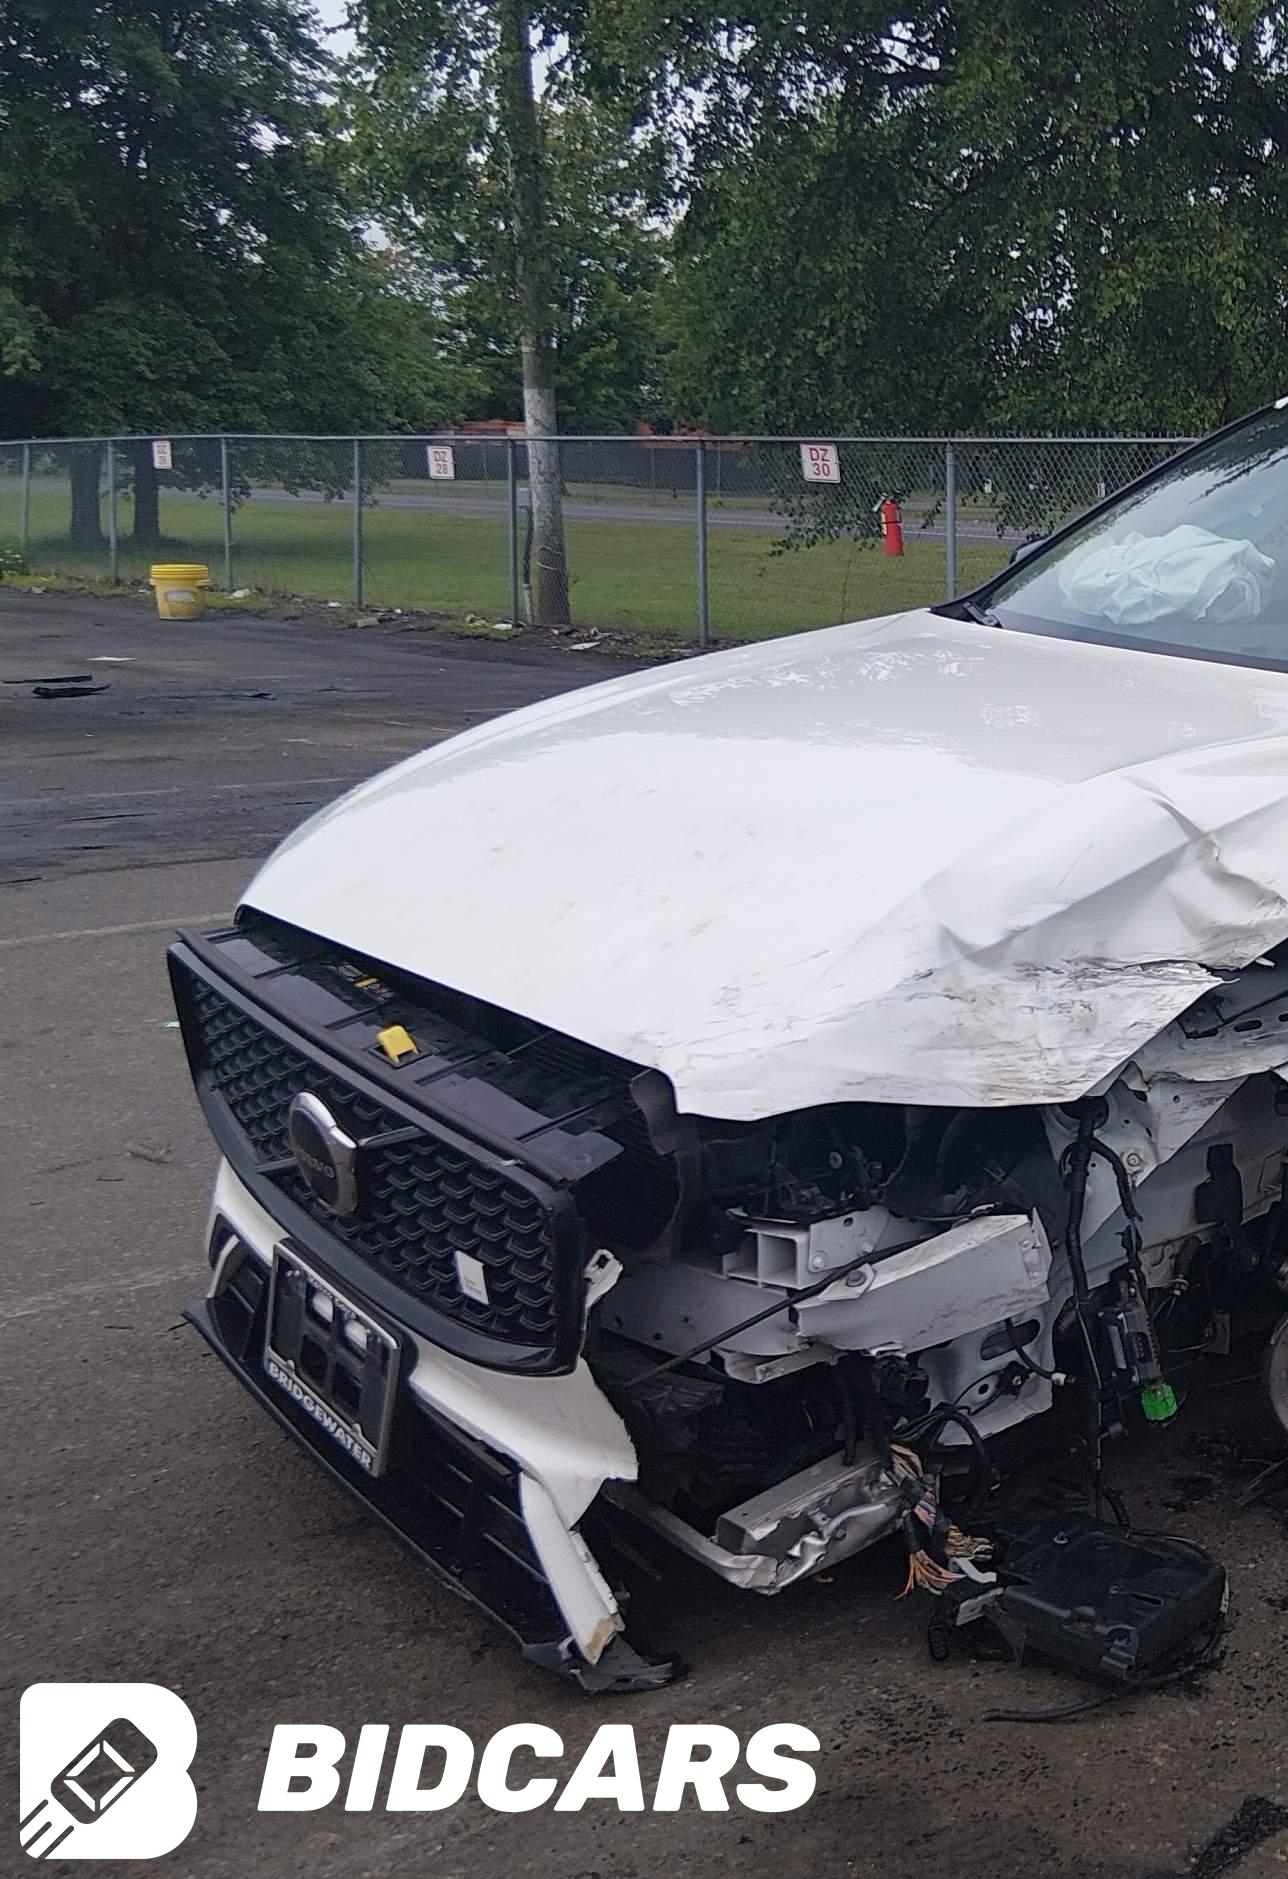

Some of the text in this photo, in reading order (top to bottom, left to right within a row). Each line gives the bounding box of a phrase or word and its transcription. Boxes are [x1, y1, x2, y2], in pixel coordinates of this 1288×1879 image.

[434, 450, 449, 462] DZ
[809, 447, 830, 461] DZ
[812, 462, 830, 477] 30
[268, 1360, 373, 1470] BRIDGEWATER
